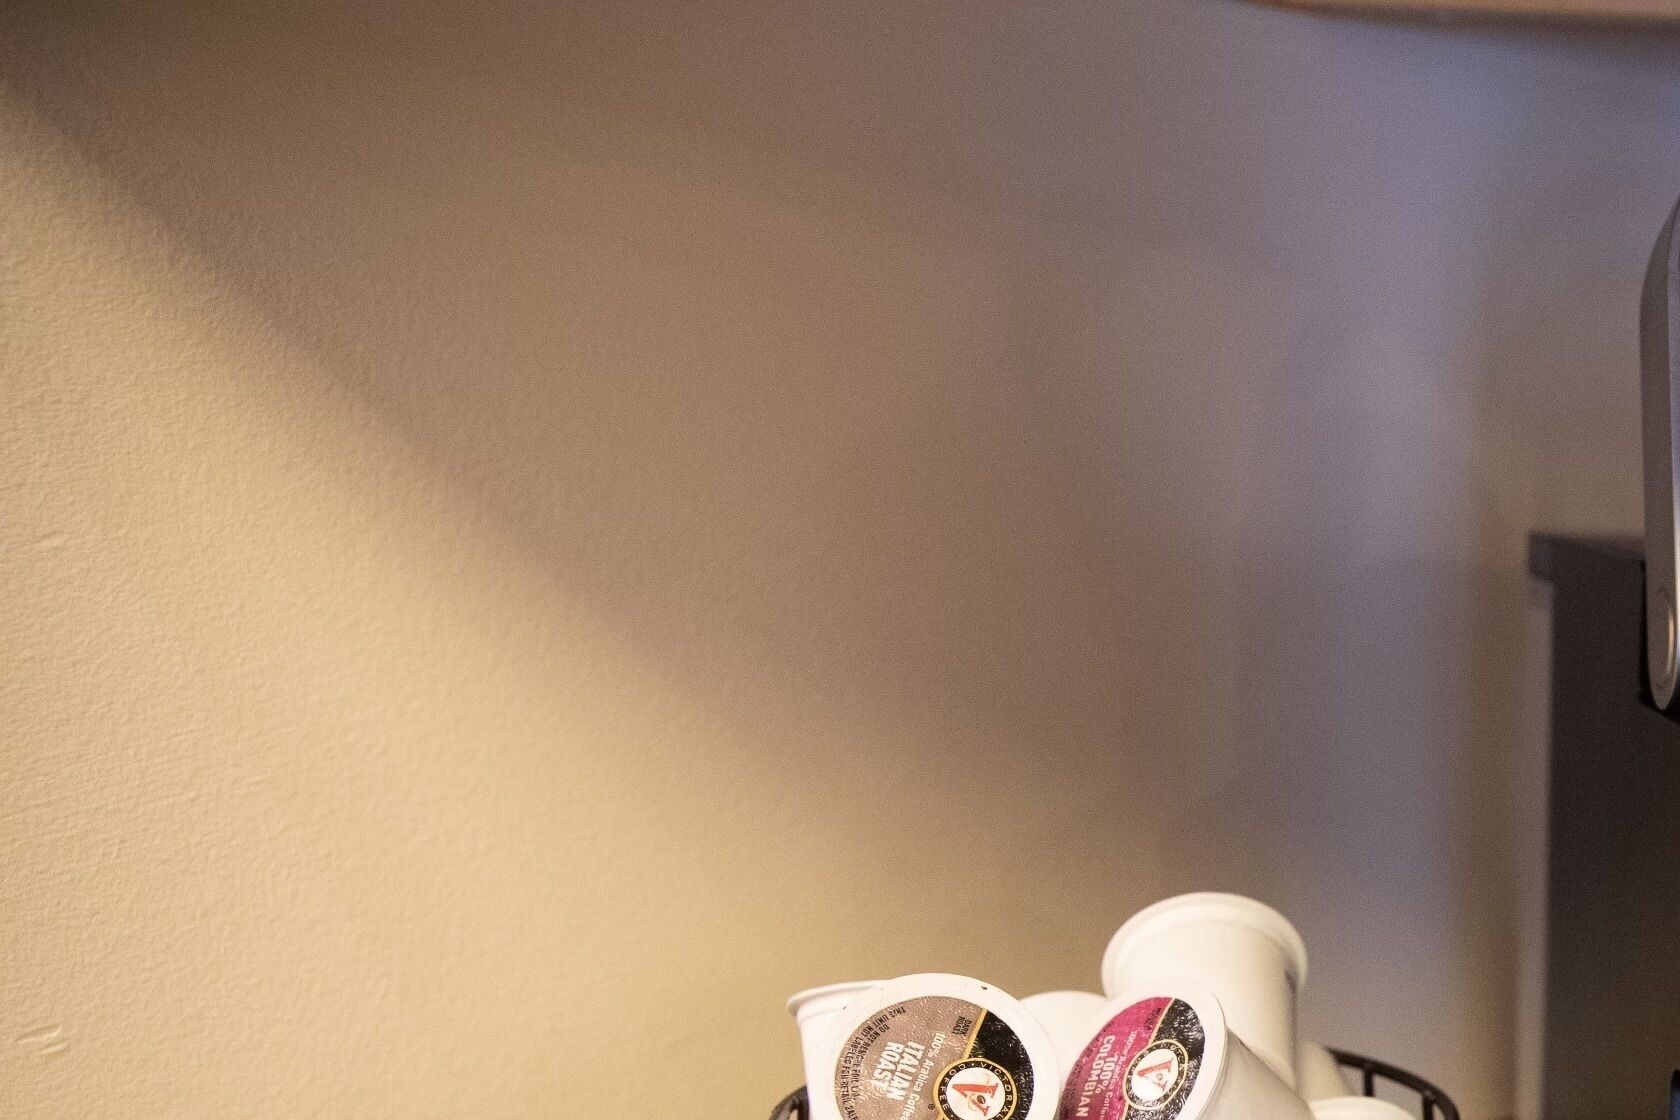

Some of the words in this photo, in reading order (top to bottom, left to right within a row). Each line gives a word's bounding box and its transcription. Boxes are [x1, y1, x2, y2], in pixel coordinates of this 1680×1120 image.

[872, 1014, 890, 1029] UNIT
[888, 1006, 907, 1018] THIS
[861, 1024, 875, 1038] NOT
[867, 1030, 881, 1044] NOT
[927, 1032, 947, 1058] 100%
[870, 1040, 906, 1094] ROAST
[886, 1040, 926, 1101] ITALIAN
[912, 1058, 935, 1092] Arabica
[980, 1061, 1013, 1102] VICTOR
[1075, 1034, 1116, 1117] COLOMBIAN
[1095, 1054, 1119, 1094] 100%
[940, 1063, 966, 1111] COFFEE
